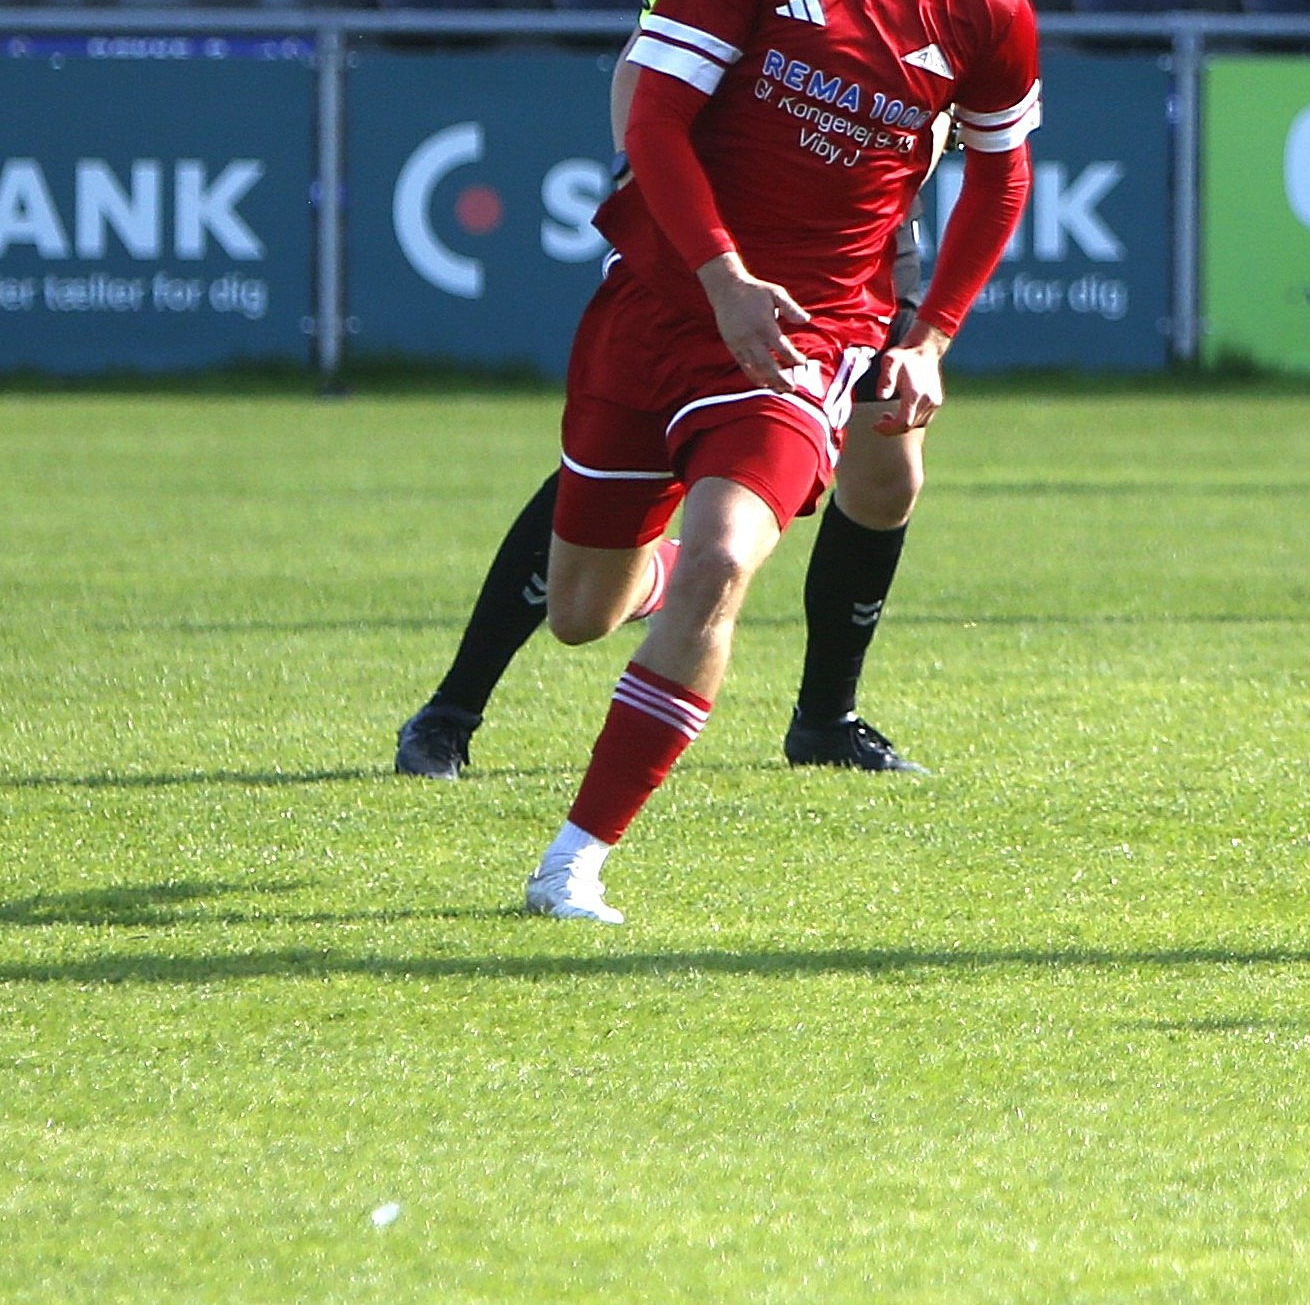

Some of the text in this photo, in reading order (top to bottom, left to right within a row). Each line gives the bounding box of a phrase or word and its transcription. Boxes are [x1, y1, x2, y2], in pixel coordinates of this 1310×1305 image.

[762, 49, 933, 131] REMA 1000
[778, 94, 874, 149] Kongevej
[799, 131, 862, 168] Viby J
[152, 271, 201, 311] for
[208, 271, 268, 320] dig
[1066, 273, 1129, 319] dig
